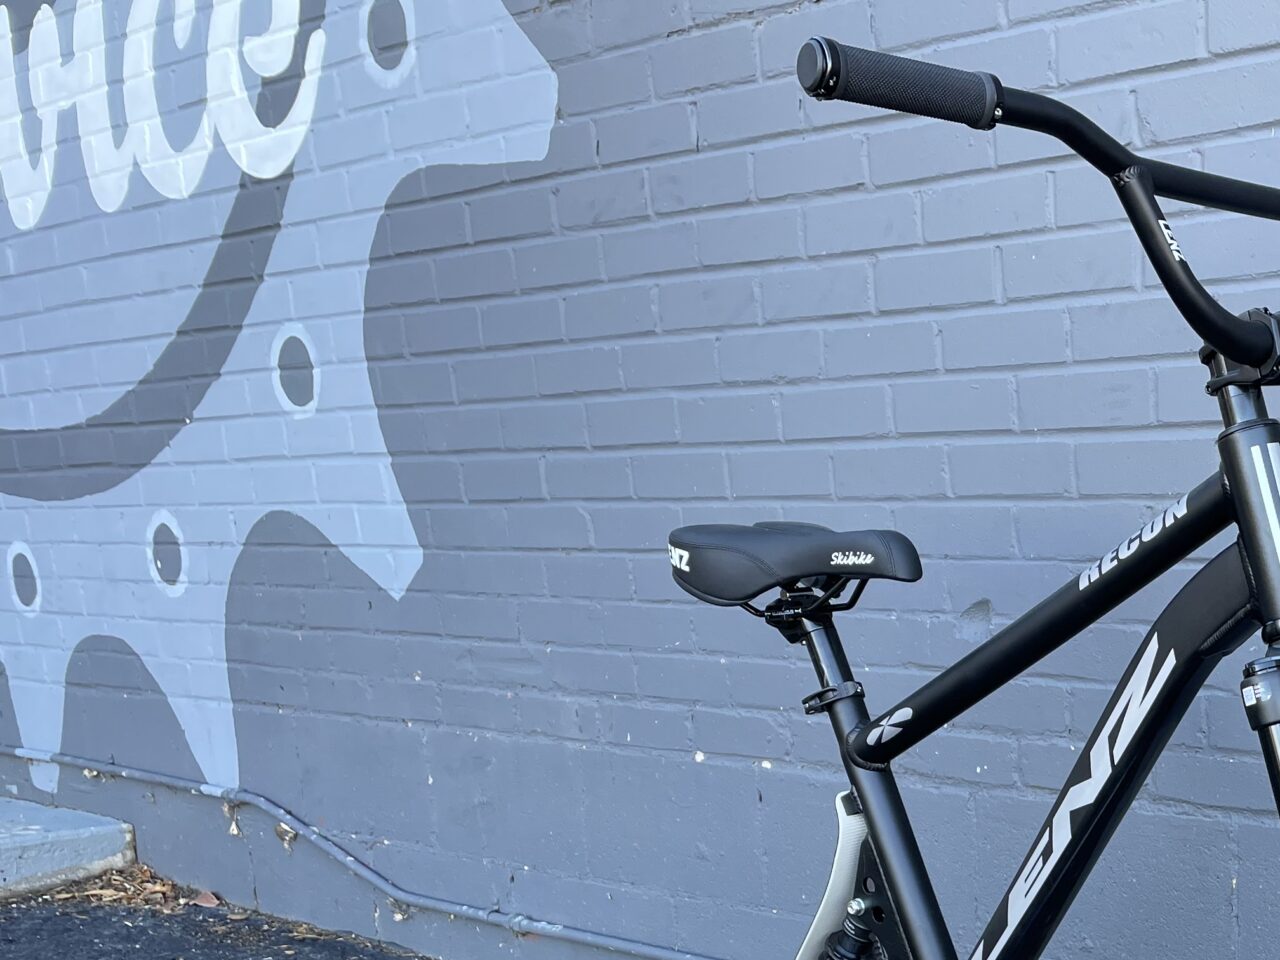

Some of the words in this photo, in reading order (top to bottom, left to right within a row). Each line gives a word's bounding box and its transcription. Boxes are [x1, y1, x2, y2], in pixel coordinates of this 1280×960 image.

[1158, 219, 1185, 261] LENZ
[830, 551, 875, 566] Skibike
[1078, 494, 1189, 591] RECON
